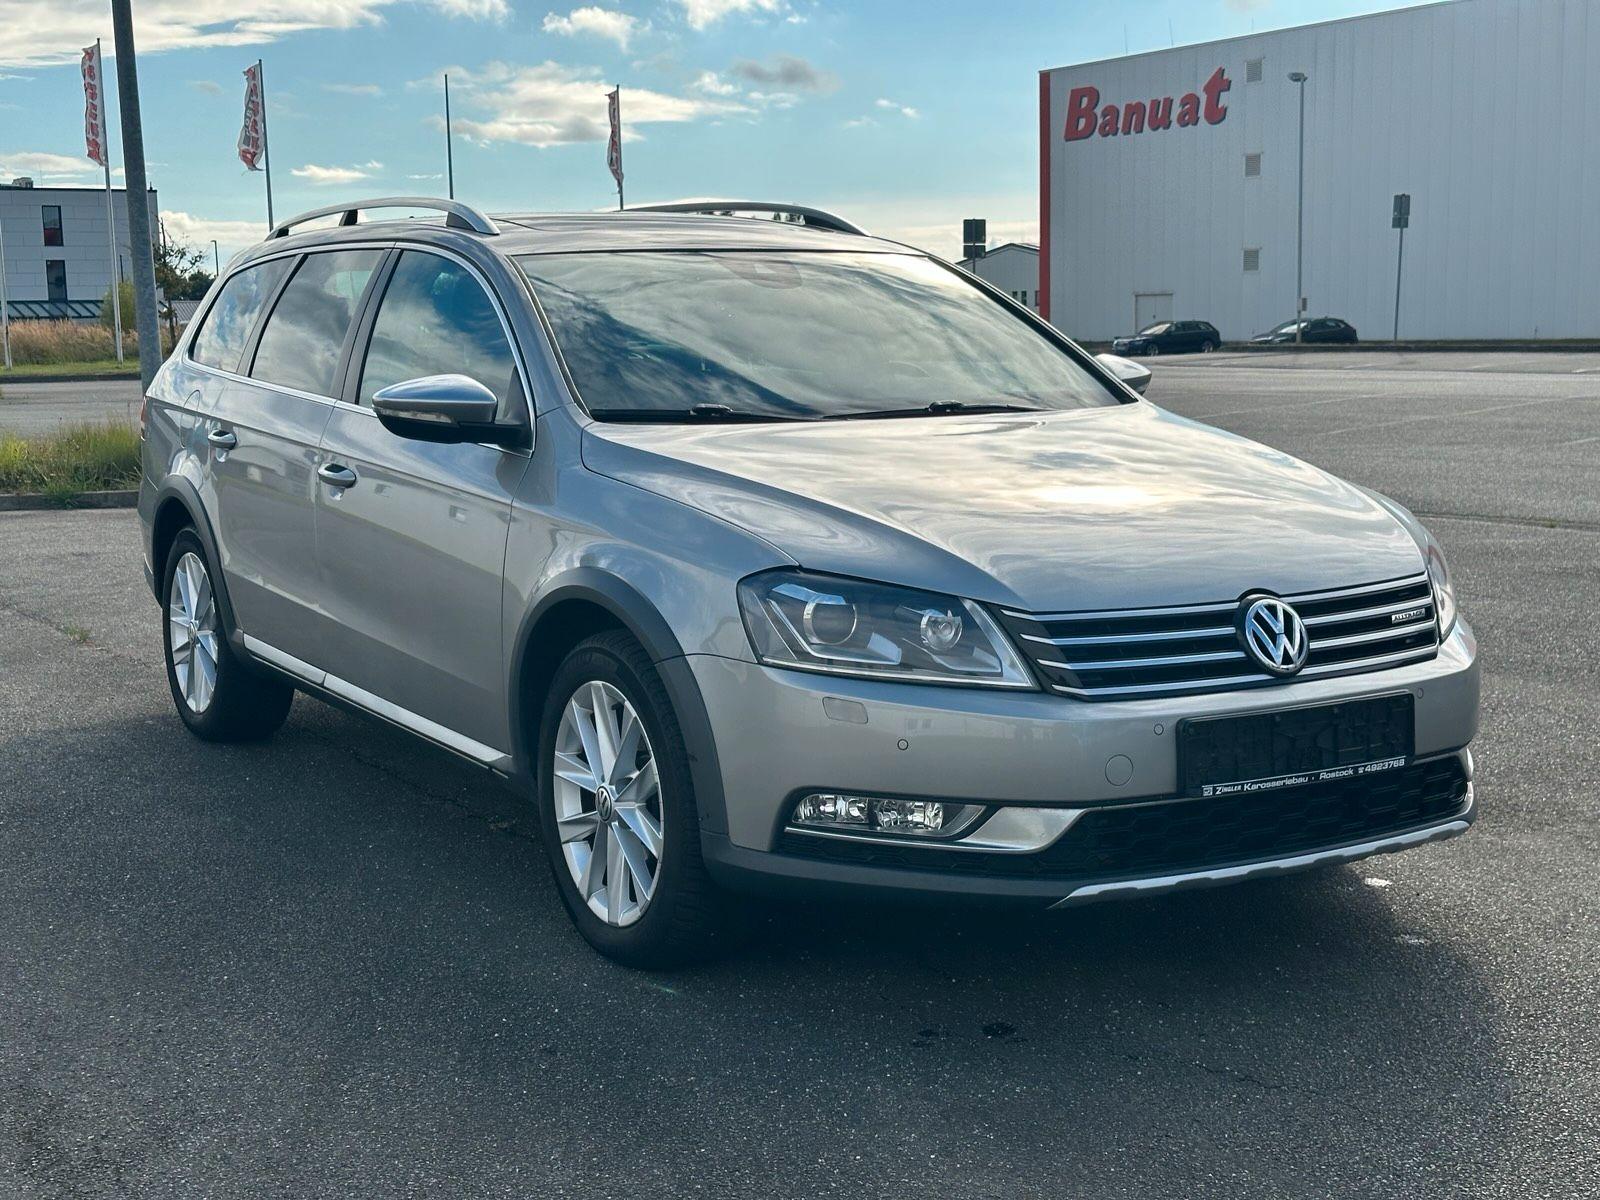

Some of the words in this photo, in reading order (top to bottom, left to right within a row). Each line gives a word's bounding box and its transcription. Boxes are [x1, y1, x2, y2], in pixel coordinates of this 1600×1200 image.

[1064, 66, 1231, 142] Banuat
[1245, 599, 1308, 672] VW
[1243, 776, 1309, 791] Karosseriebau
[1319, 767, 1354, 780] Rostock
